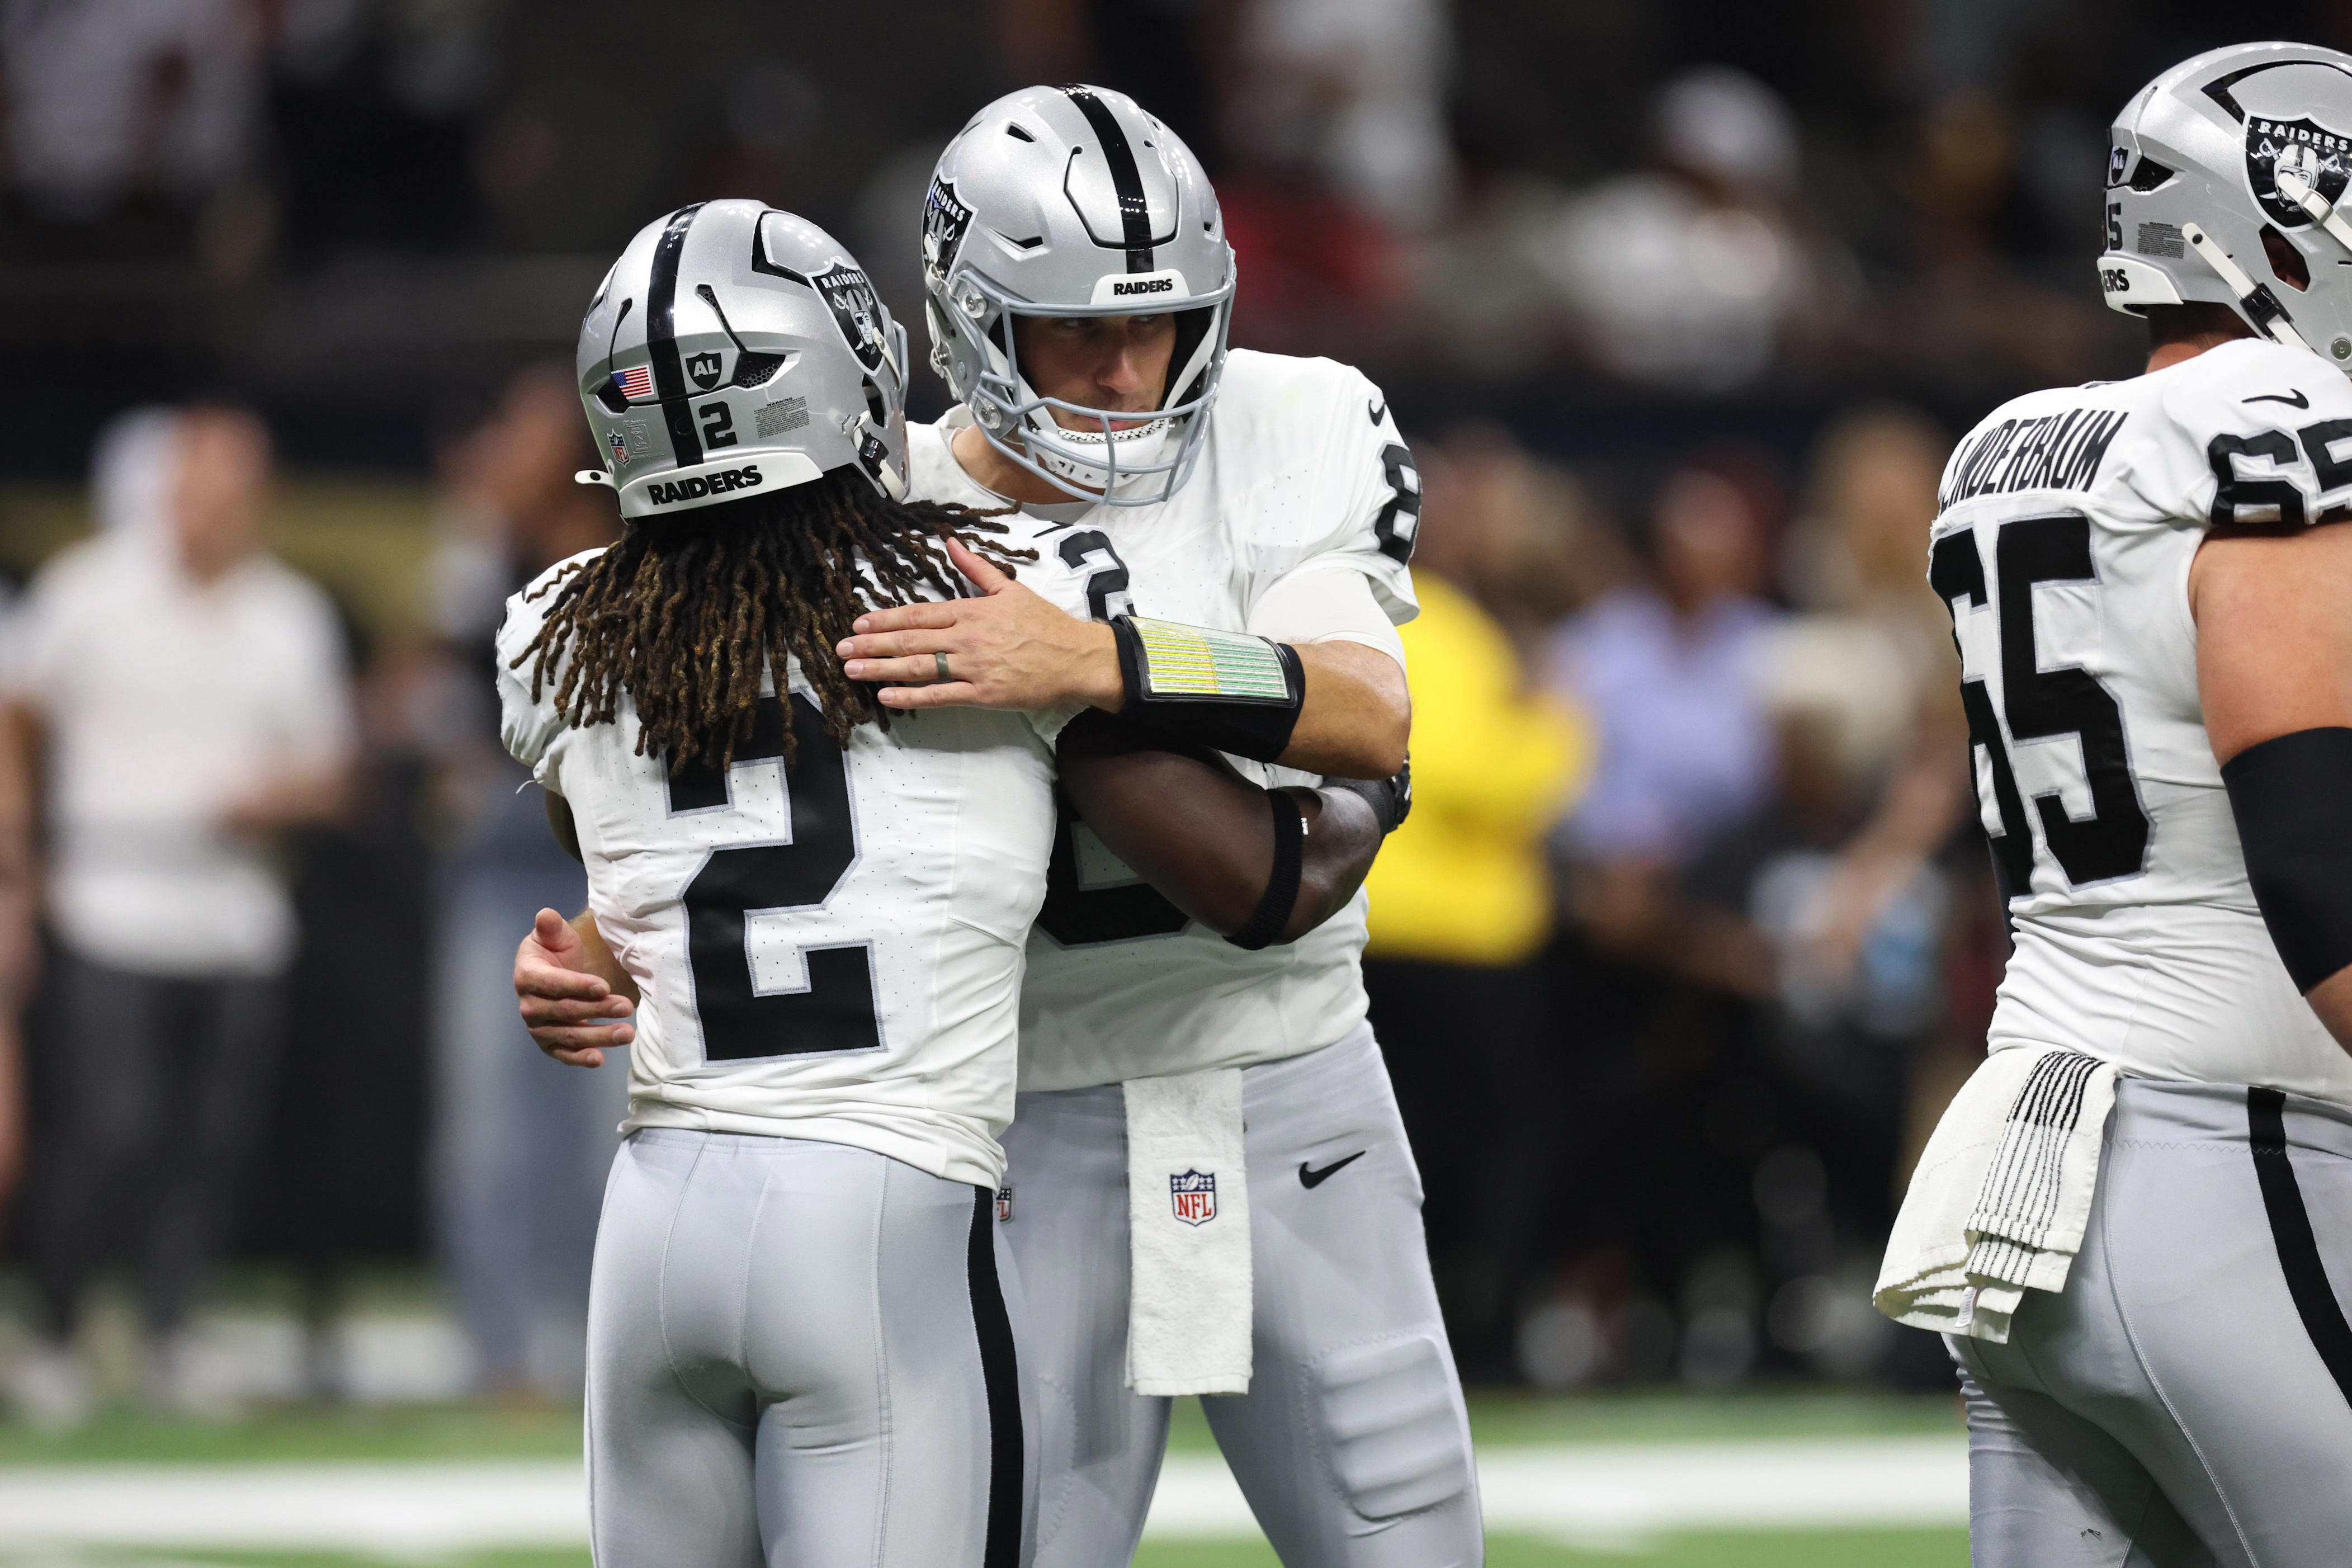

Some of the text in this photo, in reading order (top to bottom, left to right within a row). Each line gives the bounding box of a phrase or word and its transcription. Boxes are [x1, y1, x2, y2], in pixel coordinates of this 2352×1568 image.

[2257, 121, 2349, 152] RAIDERS
[820, 272, 865, 289] RAIDERS
[1113, 278, 1173, 296] RAIDERS
[693, 357, 719, 376] AL
[698, 400, 738, 450] 2
[613, 447, 630, 462] NFL
[647, 465, 763, 506] RAIDERS
[1375, 441, 1422, 569] 8
[1927, 514, 2157, 898] 65
[665, 684, 889, 1068] 2
[1177, 1194, 1211, 1220] NFL
